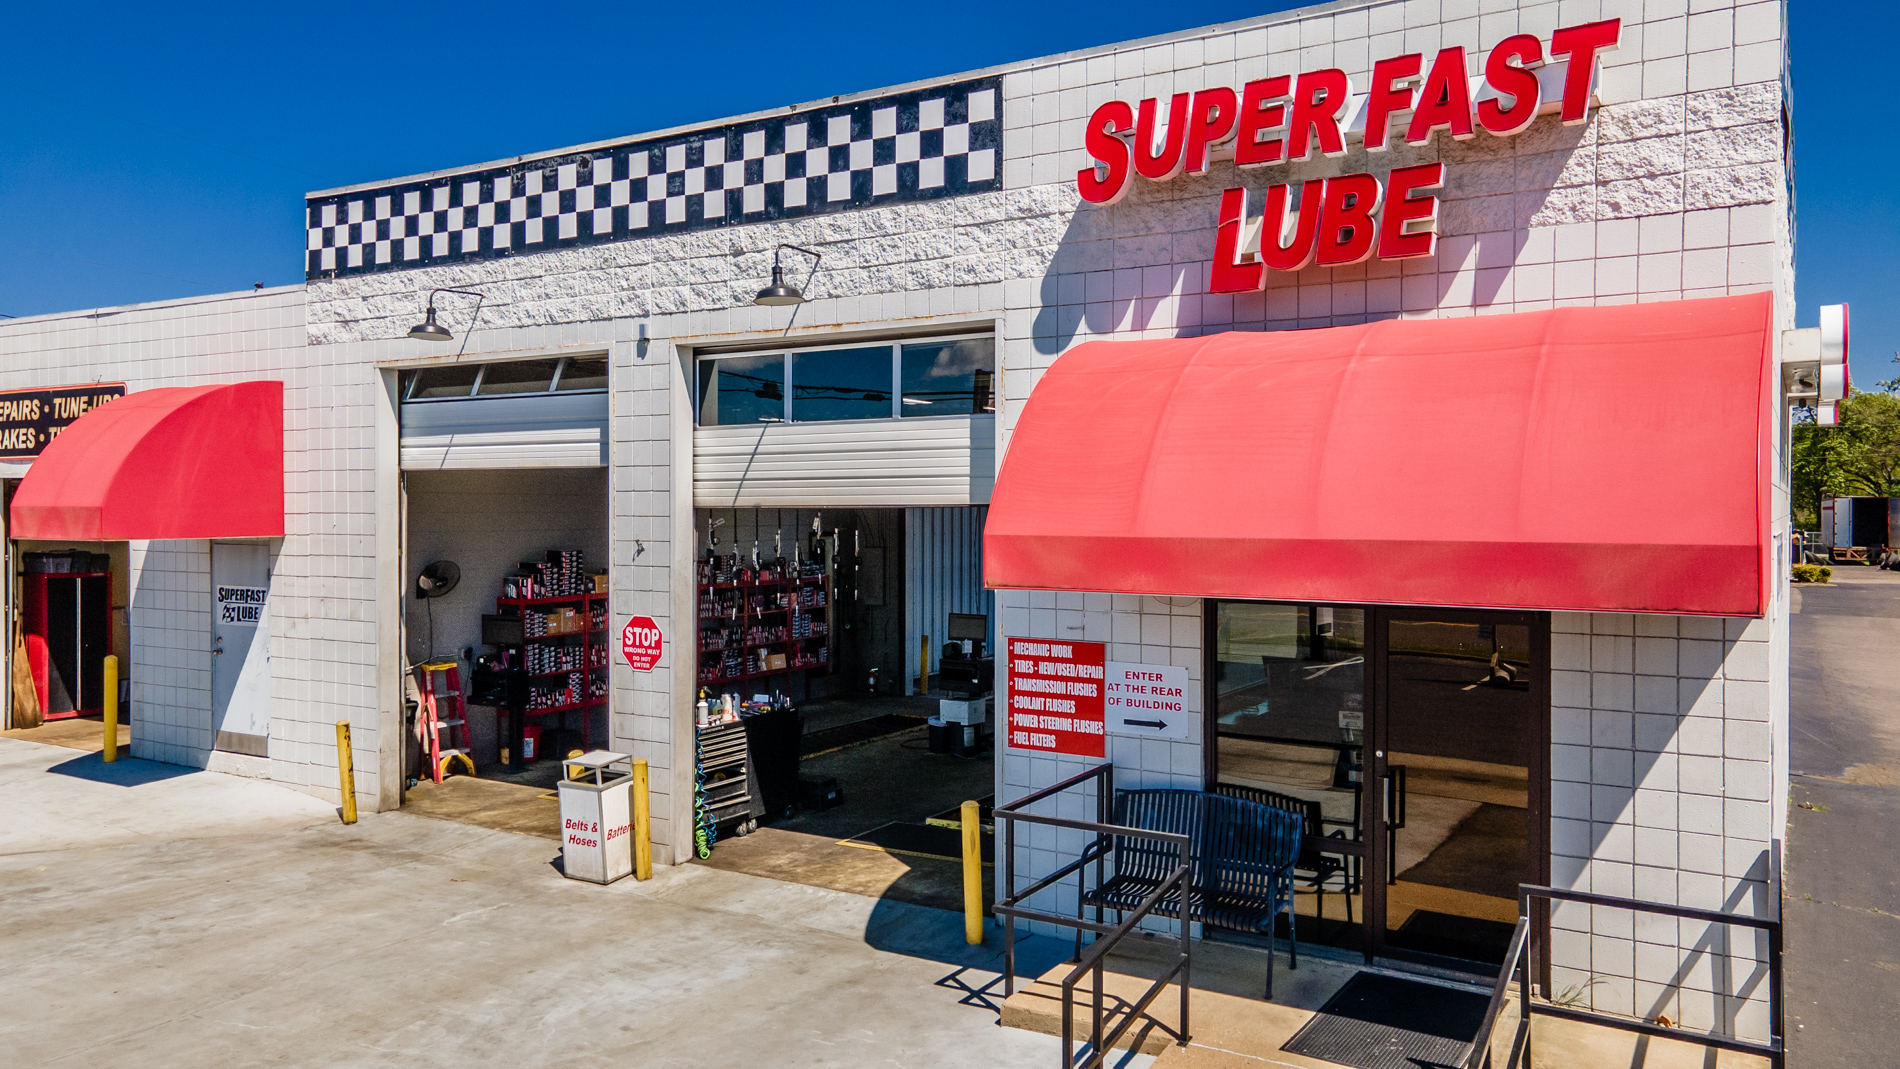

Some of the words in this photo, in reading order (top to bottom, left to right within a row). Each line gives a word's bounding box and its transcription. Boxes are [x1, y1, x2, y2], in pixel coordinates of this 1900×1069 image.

[1077, 68, 1353, 206] SUPER
[1363, 17, 1622, 152] FAST
[1209, 161, 1446, 295] LUBE
[0, 427, 36, 449] AKES
[218, 587, 267, 604] SUPERFAST
[236, 605, 259, 622] LUBE
[625, 626, 660, 647] STOP
[647, 648, 660, 656] WAY
[1014, 641, 1050, 657] MECHANIC
[1051, 644, 1073, 659] WORK
[1014, 659, 1034, 674] TIRES
[1038, 661, 1104, 679] NEW/USED/REPAIR
[1125, 671, 1163, 682] ENTER
[1014, 677, 1066, 695] TRANSMISSION
[1067, 682, 1098, 697] FLUSHES
[1107, 682, 1121, 691] AT
[1124, 684, 1147, 694] THE
[1151, 686, 1183, 697] REAR
[1013, 695, 1045, 711] COOLANT
[1045, 698, 1076, 714] FLUSHES
[1108, 697, 1122, 705] OF
[1126, 698, 1182, 712] BUILDING
[1013, 713, 1039, 729] POWER
[1039, 715, 1073, 732] STEERING
[1073, 719, 1104, 735] FLUSHES
[1013, 731, 1029, 745] FUEL
[1029, 732, 1056, 748] FILTERS
[565, 818, 588, 831] Belts
[591, 822, 598, 832] &
[568, 834, 598, 848] Hoses
